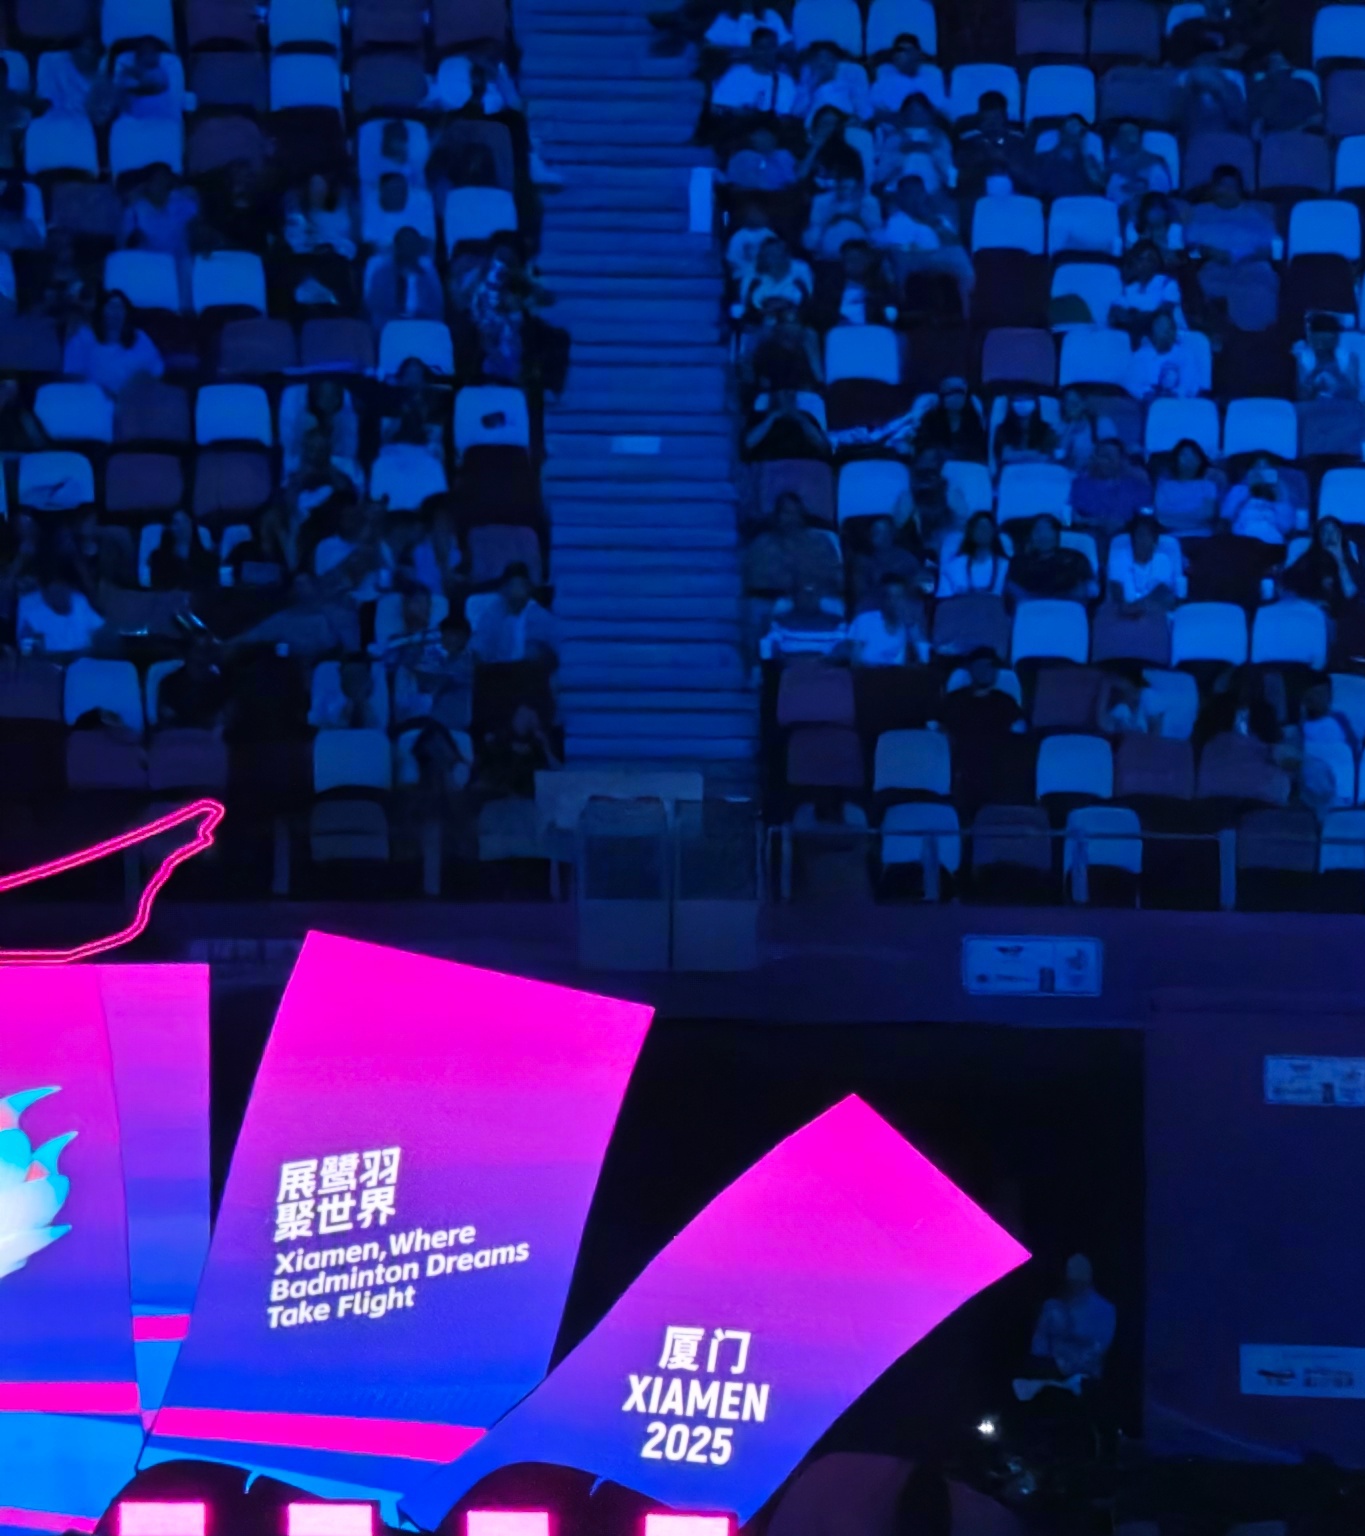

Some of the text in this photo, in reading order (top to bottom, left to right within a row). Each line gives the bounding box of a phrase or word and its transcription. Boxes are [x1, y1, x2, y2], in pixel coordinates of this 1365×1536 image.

[276, 1146, 401, 1203] 展鹭羽
[273, 1185, 396, 1242] 聚世界
[270, 1242, 530, 1302] Badminton Dreams
[267, 1285, 416, 1329] Take Flight
[657, 1325, 752, 1375] 厦门
[621, 1374, 770, 1423] XIAMEN
[640, 1420, 734, 1466] 2025
